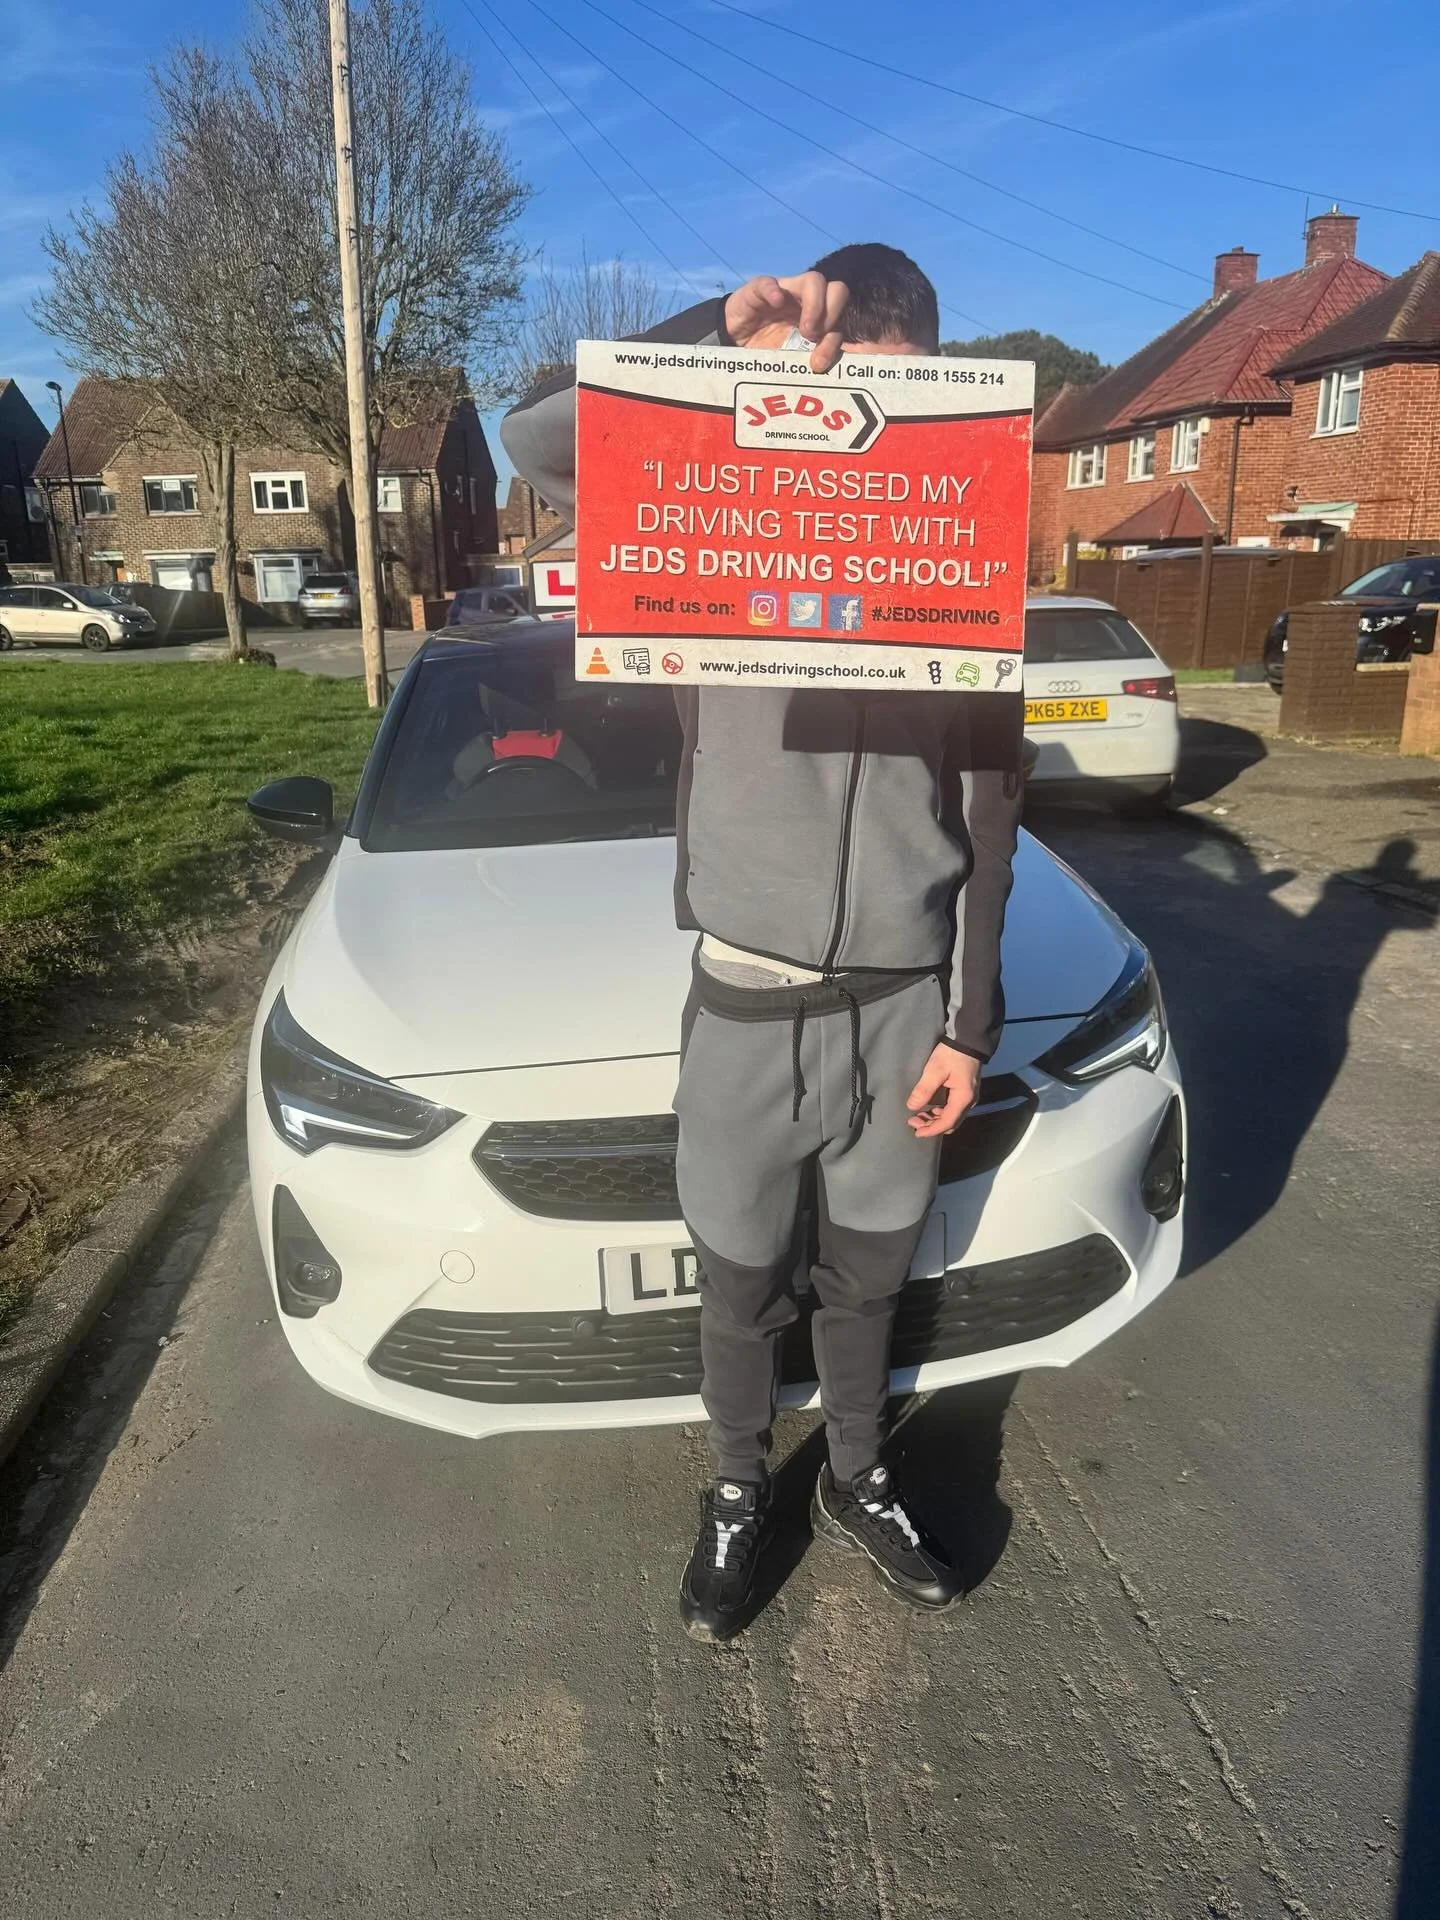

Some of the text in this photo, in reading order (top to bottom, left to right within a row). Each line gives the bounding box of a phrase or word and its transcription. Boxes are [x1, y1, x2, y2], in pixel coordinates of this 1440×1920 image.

[615, 352, 1005, 386] www.jedsdrivingschool.co. Call on: 0808 1555 214
[742, 394, 852, 431] JEDS
[765, 431, 831, 442] DRIVING SCHOOL
[674, 463, 764, 495] JUST
[773, 467, 911, 502] PASSED
[921, 474, 973, 504] MY
[636, 503, 976, 547] DRIVING TEST WITH
[600, 544, 687, 575] JEDS
[697, 549, 834, 581] DRIVING
[634, 595, 736, 616] Find us on:
[871, 606, 1001, 625] #JEDSDRIVING
[699, 660, 906, 679] www.jedsdrivingschool.co.uk
[1025, 700, 1100, 719] PK65 ZXE
